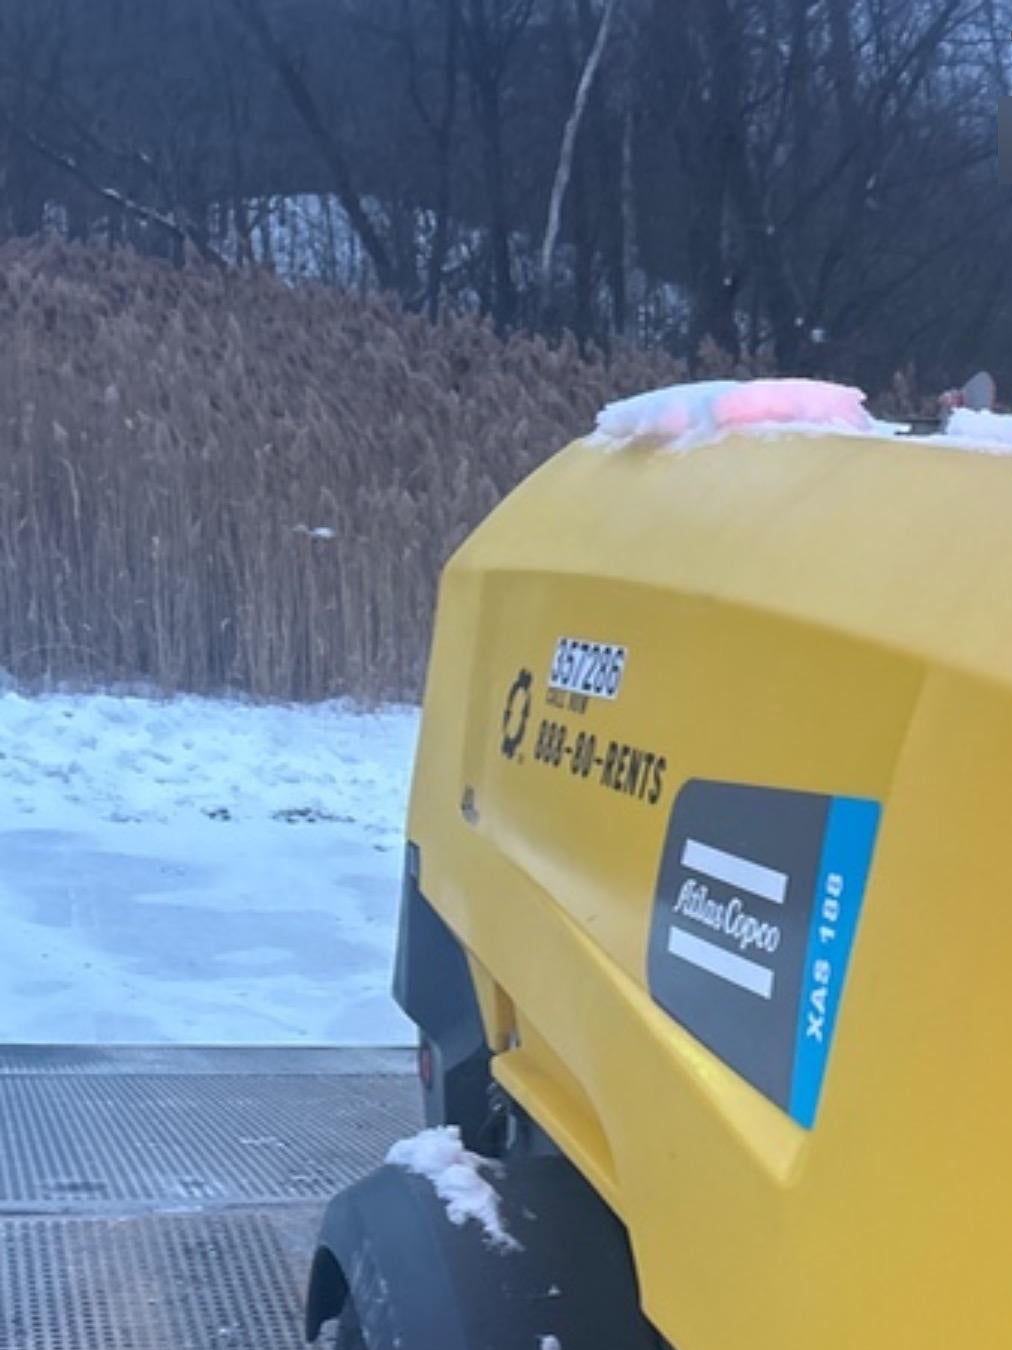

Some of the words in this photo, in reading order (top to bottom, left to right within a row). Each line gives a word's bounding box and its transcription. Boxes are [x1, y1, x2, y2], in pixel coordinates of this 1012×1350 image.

[551, 638, 624, 695] 357286
[534, 719, 667, 805] 888-80-RENTS
[673, 878, 724, 930] Atlas
[724, 897, 781, 952] Copco
[806, 959, 832, 1042] XAS
